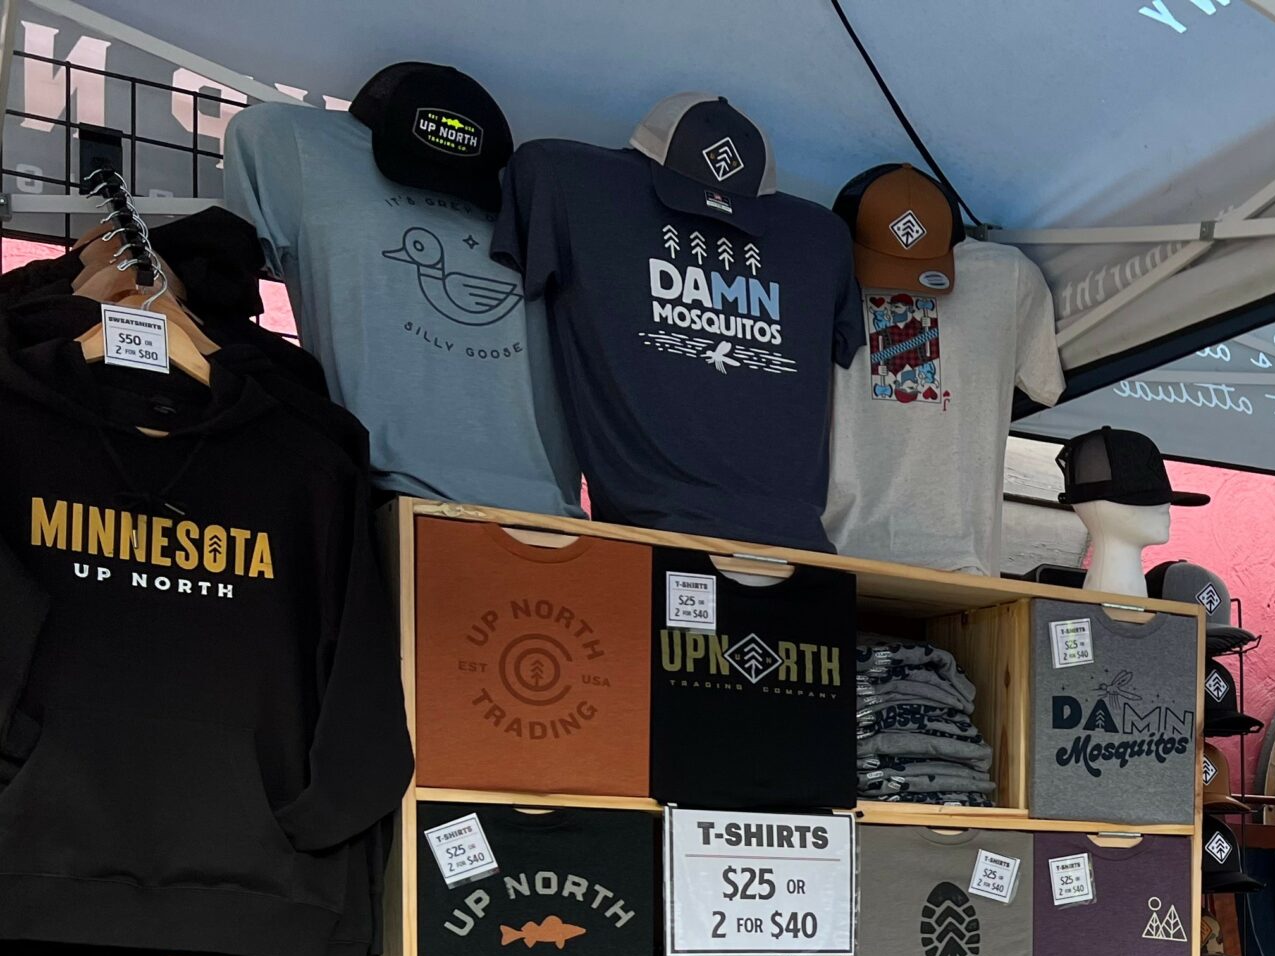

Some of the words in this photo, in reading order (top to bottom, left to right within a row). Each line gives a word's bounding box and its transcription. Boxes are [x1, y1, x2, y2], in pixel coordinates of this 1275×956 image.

[419, 119, 436, 131] UP
[439, 126, 478, 147] NORTH
[649, 258, 780, 321] DAMN
[652, 300, 782, 345] MOSQUITOS
[116, 346, 122, 355] 2
[138, 348, 158, 360] $80
[118, 333, 142, 346] $50
[404, 321, 454, 350] SILLY
[465, 342, 523, 360] GOOSE
[30, 497, 274, 579] MINNESOTA
[73, 562, 112, 581] UP
[131, 572, 234, 598] NORTH
[674, 608, 680, 616] 2
[693, 609, 708, 619] $40
[678, 594, 696, 606] $25
[466, 610, 501, 647] UP
[509, 599, 605, 661] NORTH
[457, 660, 488, 672] EST
[581, 674, 611, 687] USA
[669, 679, 743, 691] TRADING
[762, 686, 838, 699] COMPANY
[471, 687, 599, 740] TRADING
[1052, 695, 1194, 739] DAMN
[1055, 732, 1190, 778] Mosquitos
[435, 826, 473, 842] T-SHIRTS
[697, 821, 829, 850] T-SHIRTS
[445, 844, 466, 859] $25
[447, 862, 455, 872] 2
[466, 852, 485, 866] $40
[722, 865, 776, 901] $25
[786, 878, 806, 895] OR
[976, 878, 982, 887] 2
[992, 883, 1004, 892] $40
[982, 868, 997, 880] $25
[444, 888, 490, 937] UP
[503, 870, 636, 928] NORTH
[711, 910, 727, 939] 2
[736, 917, 763, 934] FOR
[770, 910, 818, 940] $40
